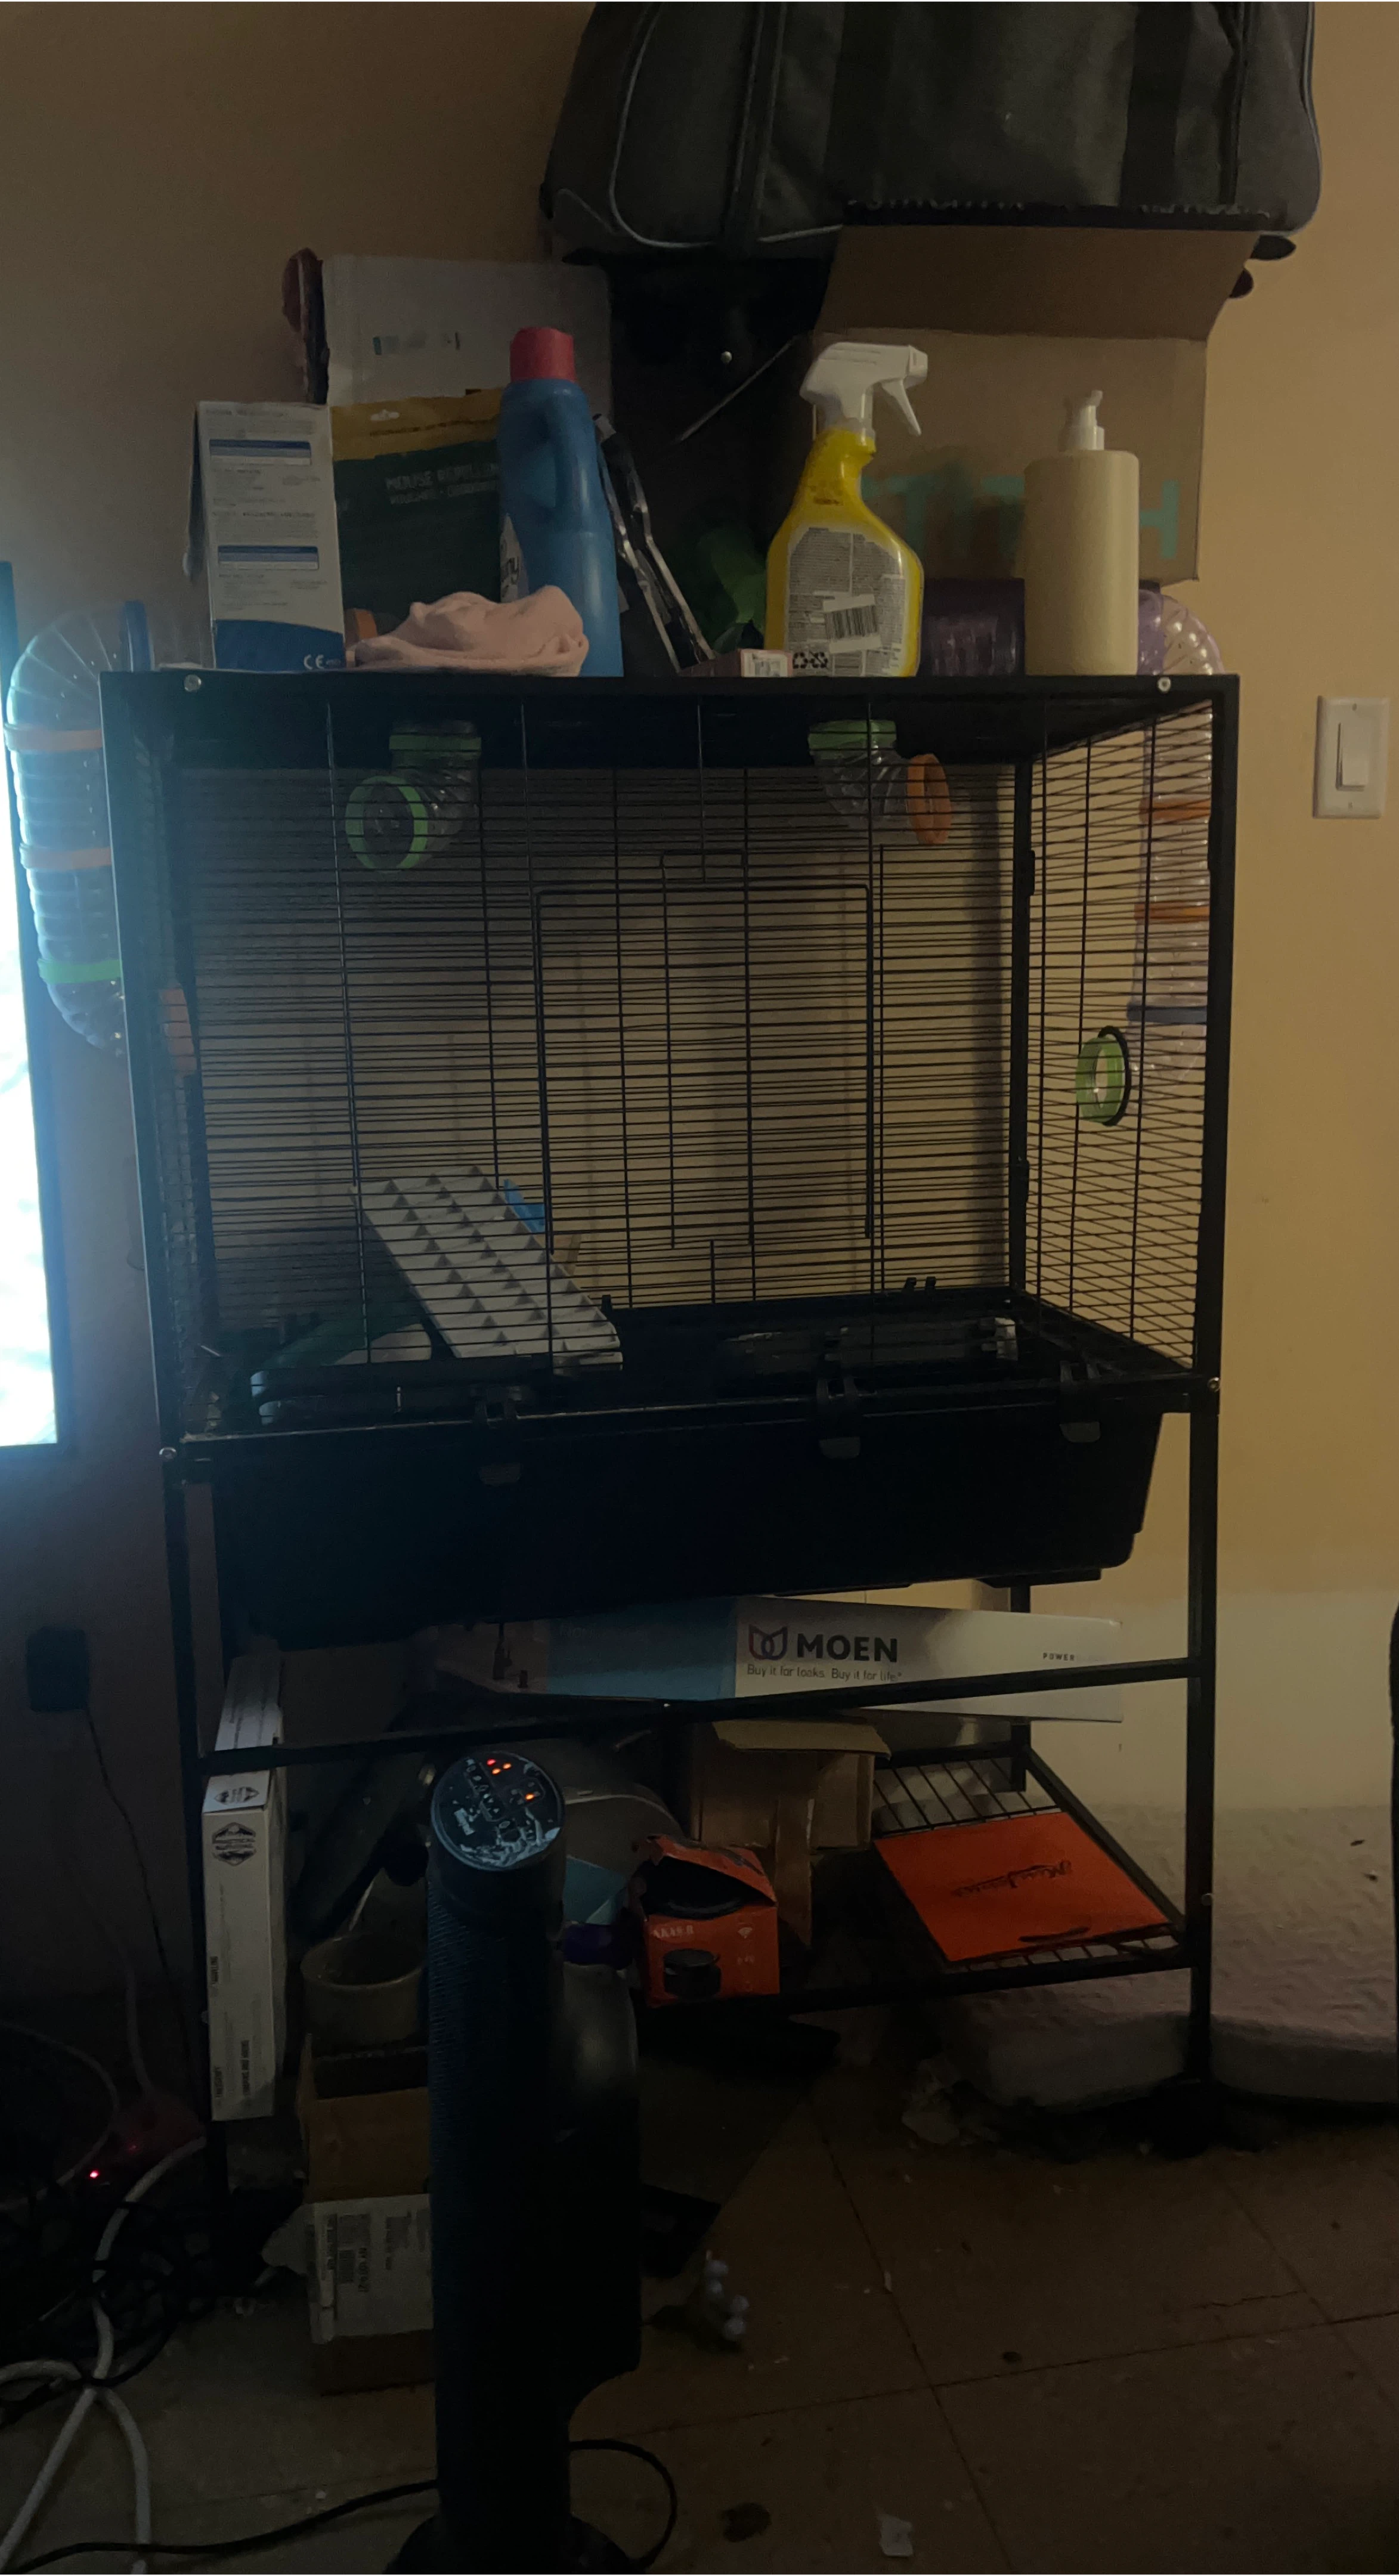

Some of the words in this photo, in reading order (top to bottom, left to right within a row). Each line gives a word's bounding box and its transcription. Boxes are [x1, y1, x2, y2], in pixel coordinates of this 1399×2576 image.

[797, 1633, 897, 1662] MOEN
[1043, 1652, 1075, 1661] POWER
[747, 1664, 766, 1677] Buy
[770, 1665, 776, 1676] it
[780, 1665, 794, 1676] for
[831, 1668, 850, 1682] Buy
[853, 1669, 860, 1679] it
[863, 1670, 877, 1680] for
